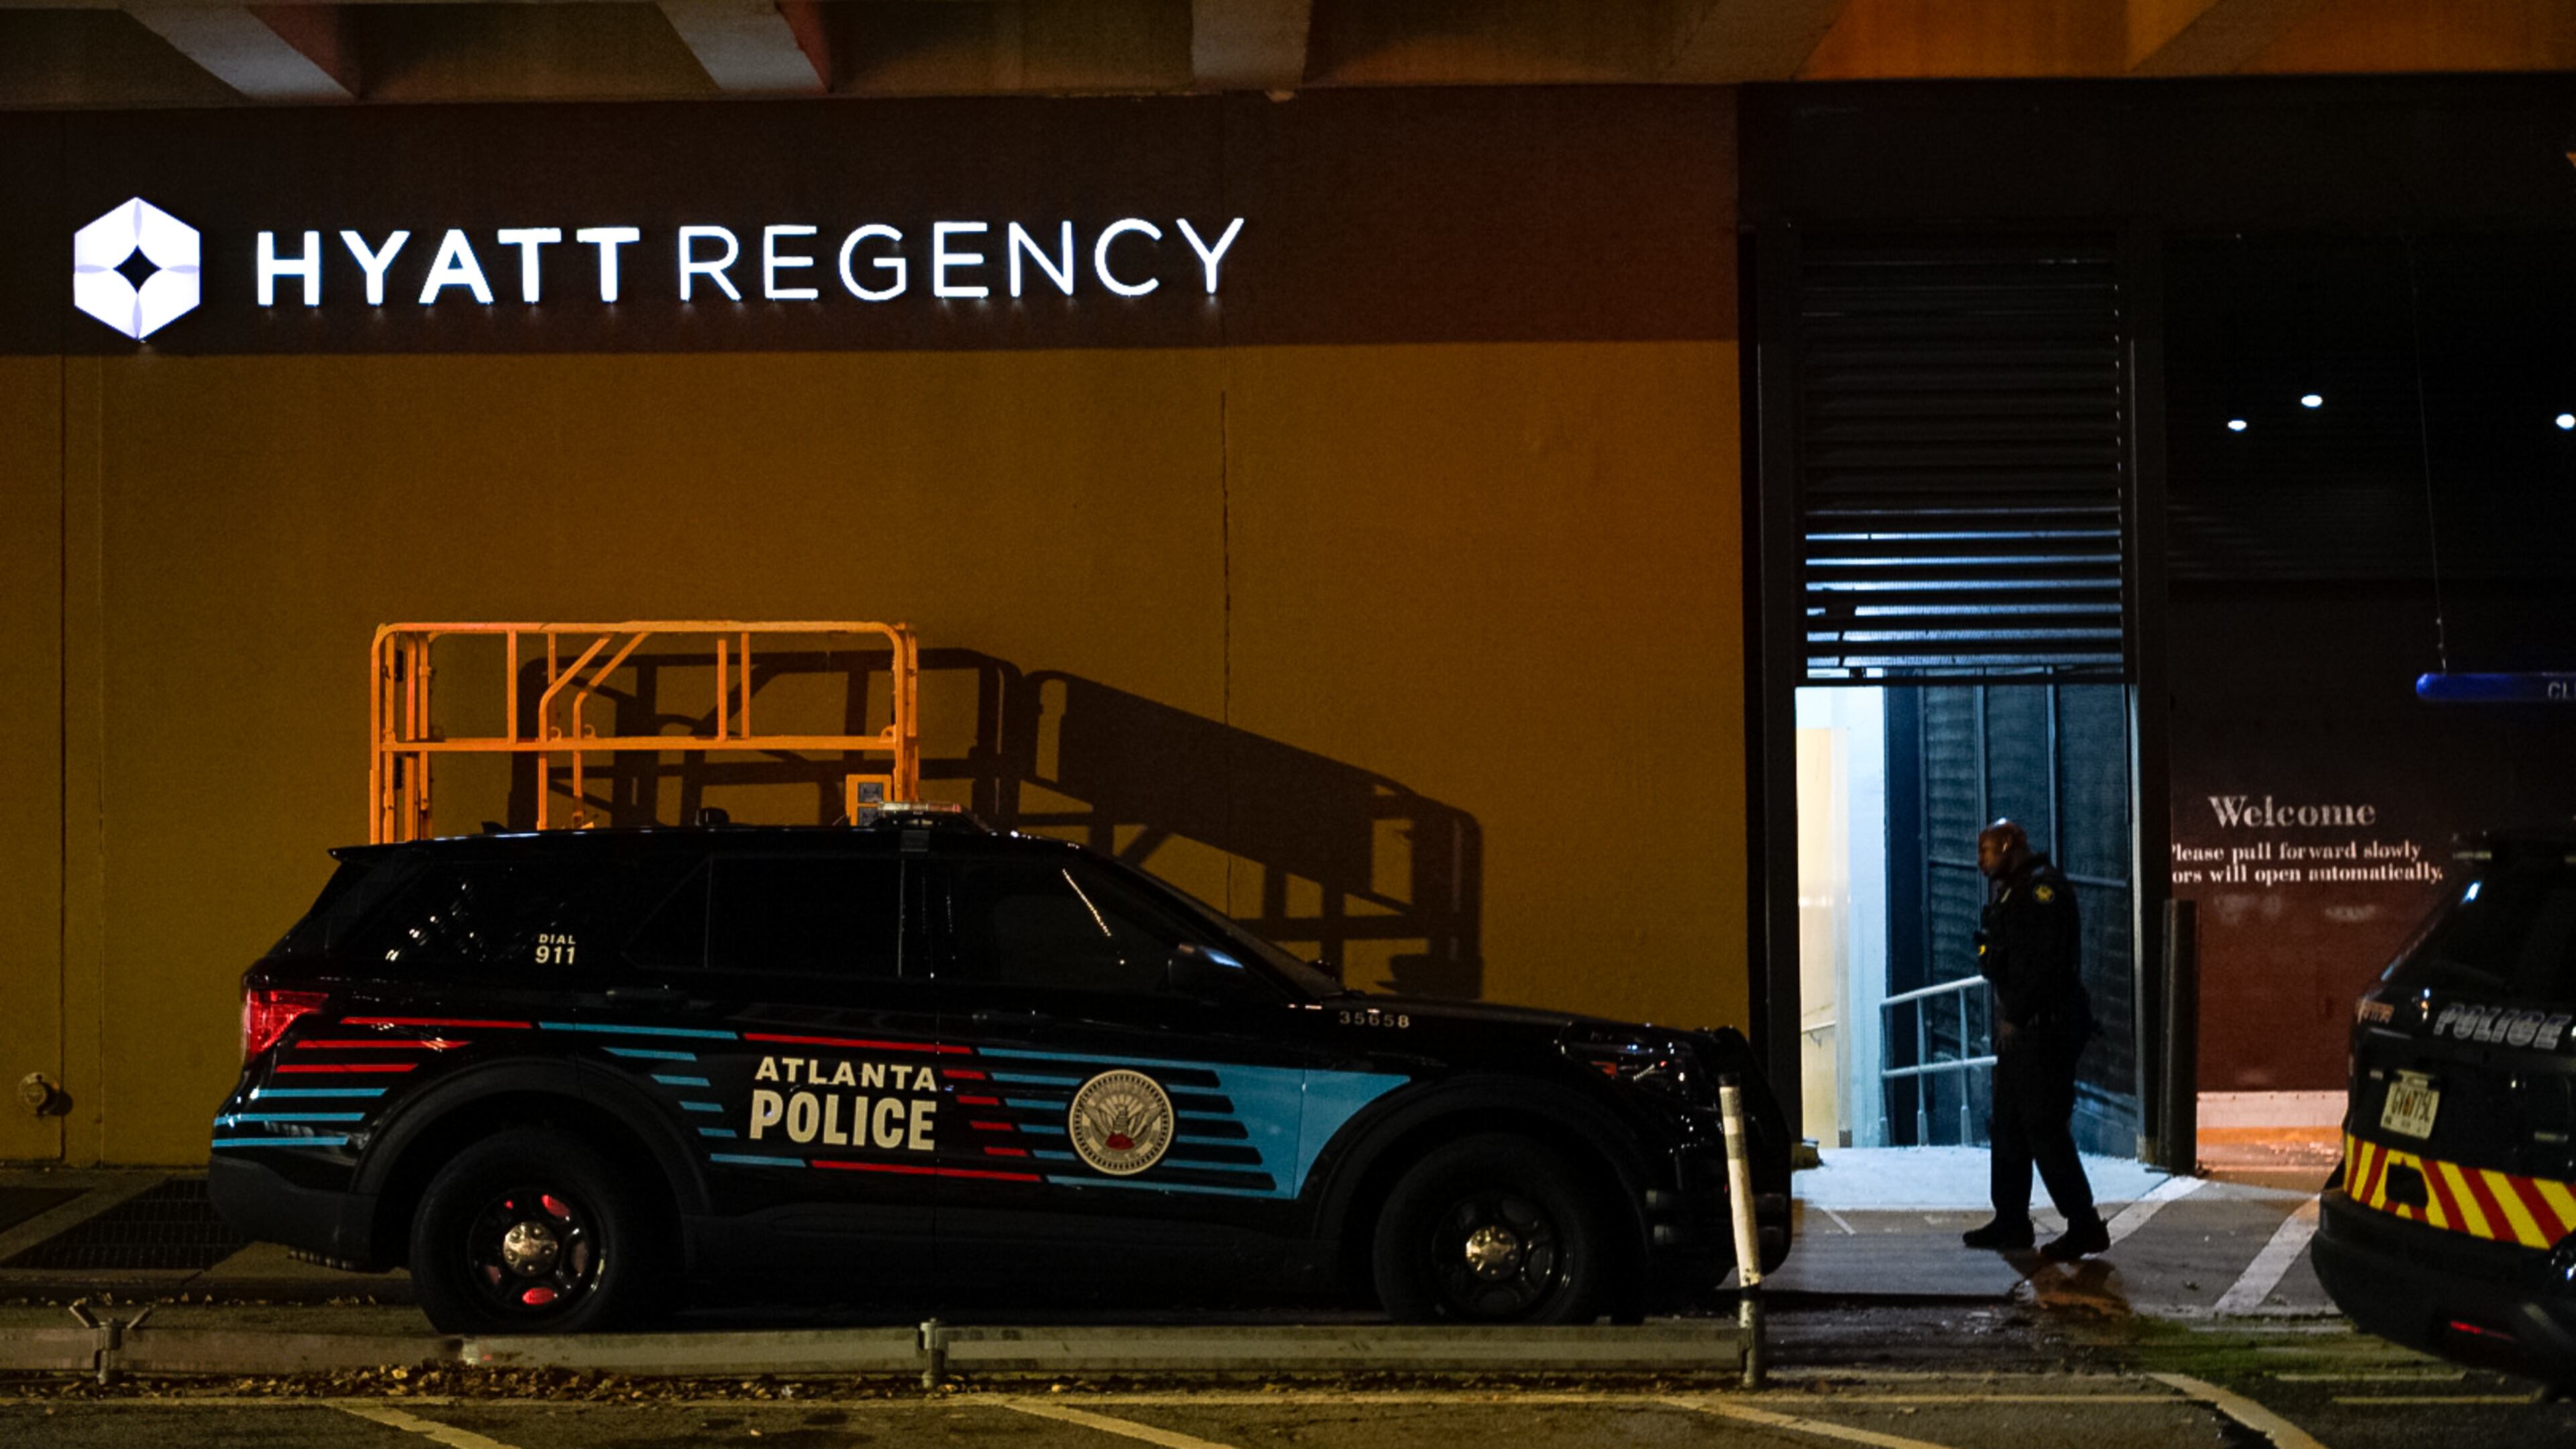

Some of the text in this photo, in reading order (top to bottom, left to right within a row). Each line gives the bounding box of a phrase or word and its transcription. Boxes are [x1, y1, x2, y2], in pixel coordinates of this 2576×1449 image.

[257, 217, 1244, 307] HYATT REGENCY
[2207, 794, 2377, 828] Welcome
[2232, 841, 2271, 865] pull
[2279, 840, 2357, 860] forward
[2363, 839, 2421, 863] slowly
[2171, 861, 2444, 888] ors will open automatically.
[535, 945, 576, 965] 911
[538, 933, 577, 945] DIAL
[2433, 1003, 2573, 1050] POLICE
[755, 1056, 937, 1091] ATLANTA
[749, 1089, 936, 1150] POLICE
